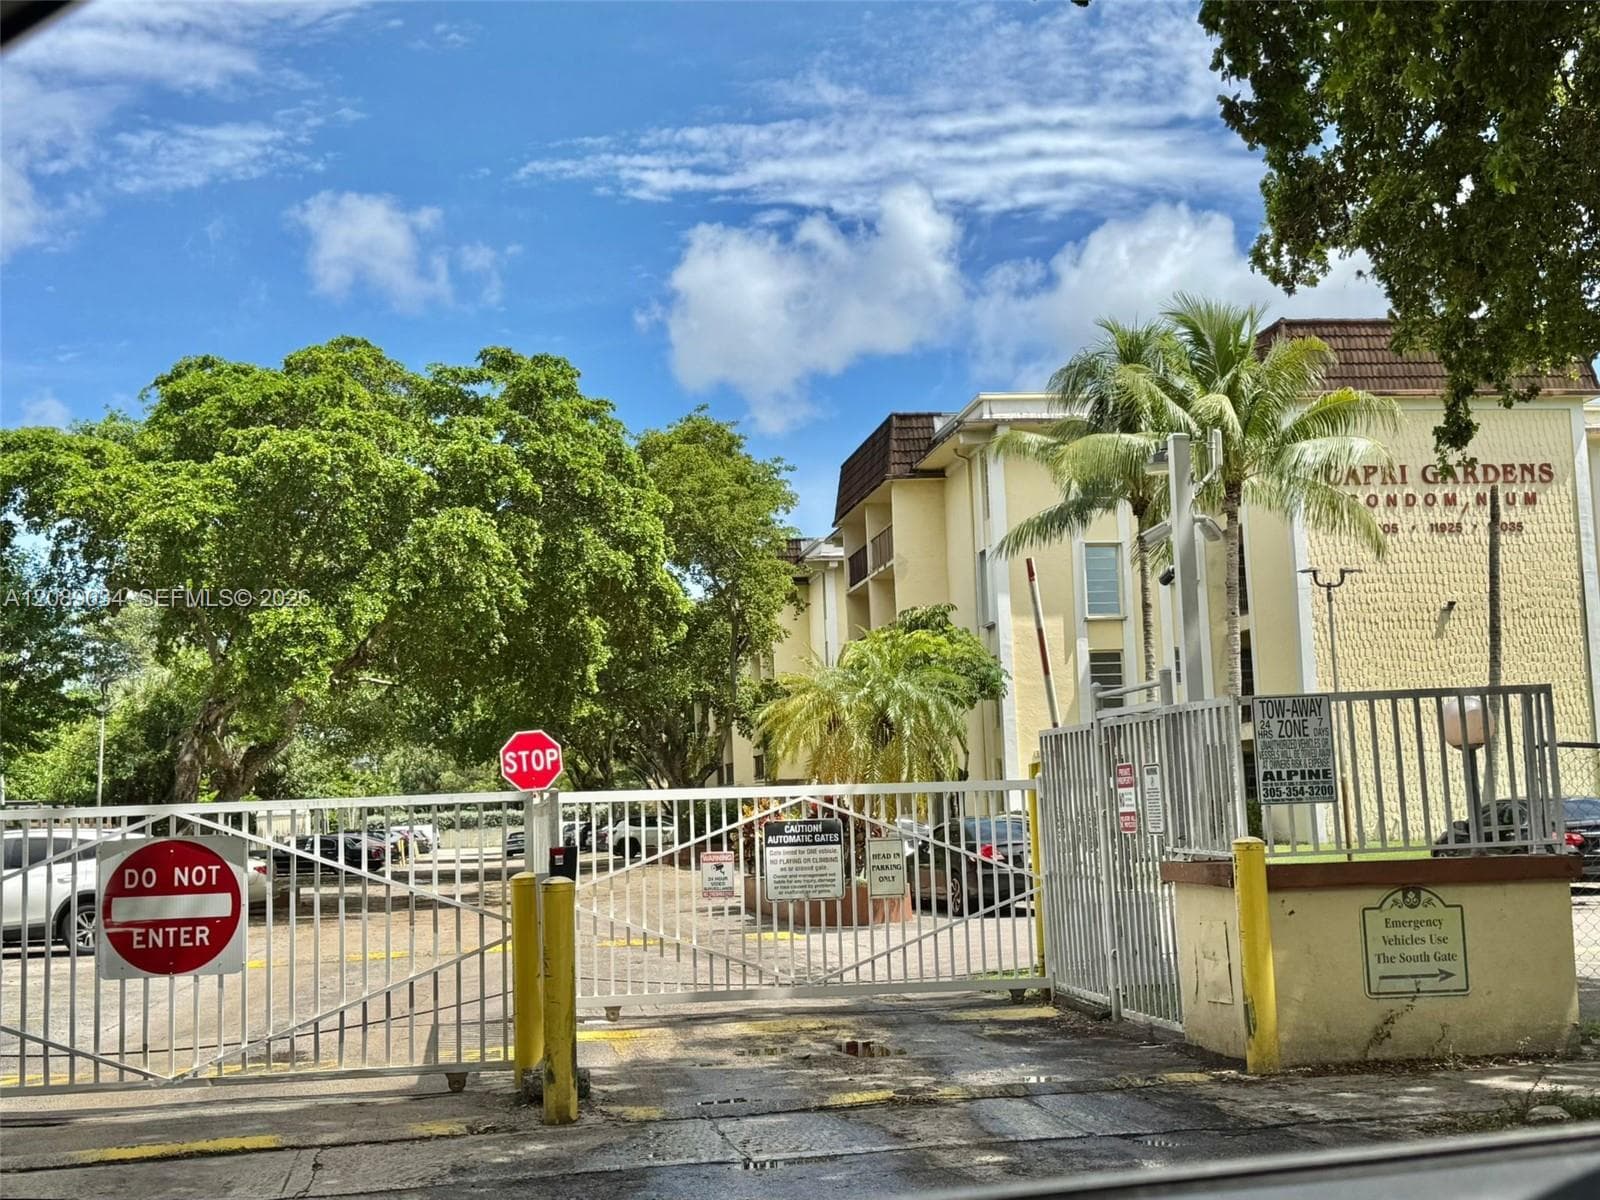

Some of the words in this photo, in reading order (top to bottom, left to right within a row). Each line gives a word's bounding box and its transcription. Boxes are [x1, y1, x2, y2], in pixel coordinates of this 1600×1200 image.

[1429, 522, 1462, 533] 11925
[1259, 698, 1322, 719] TOW-AWAY
[1260, 720, 1271, 729] 24
[1317, 717, 1324, 726] 7
[1258, 730, 1273, 739] HRS
[1277, 719, 1309, 738] ZONE
[1313, 728, 1329, 737] DAYS
[504, 748, 558, 774] STOP
[1262, 769, 1332, 781] ALPINE
[1263, 785, 1334, 798] 305-354-3200
[784, 823, 823, 833] CAUTION!
[767, 834, 813, 844] AUTOMATIC
[814, 833, 839, 842] GATES
[871, 864, 902, 872] PARKING
[124, 868, 157, 889] DO
[174, 865, 221, 887] NOT
[1384, 917, 1444, 930] Emergency
[132, 926, 210, 949] ENTER
[1382, 934, 1426, 946] Vehicles
[1429, 933, 1449, 945] Use
[1374, 952, 1396, 964] The
[1399, 951, 1430, 963] South
[1433, 951, 1458, 962] Gate
